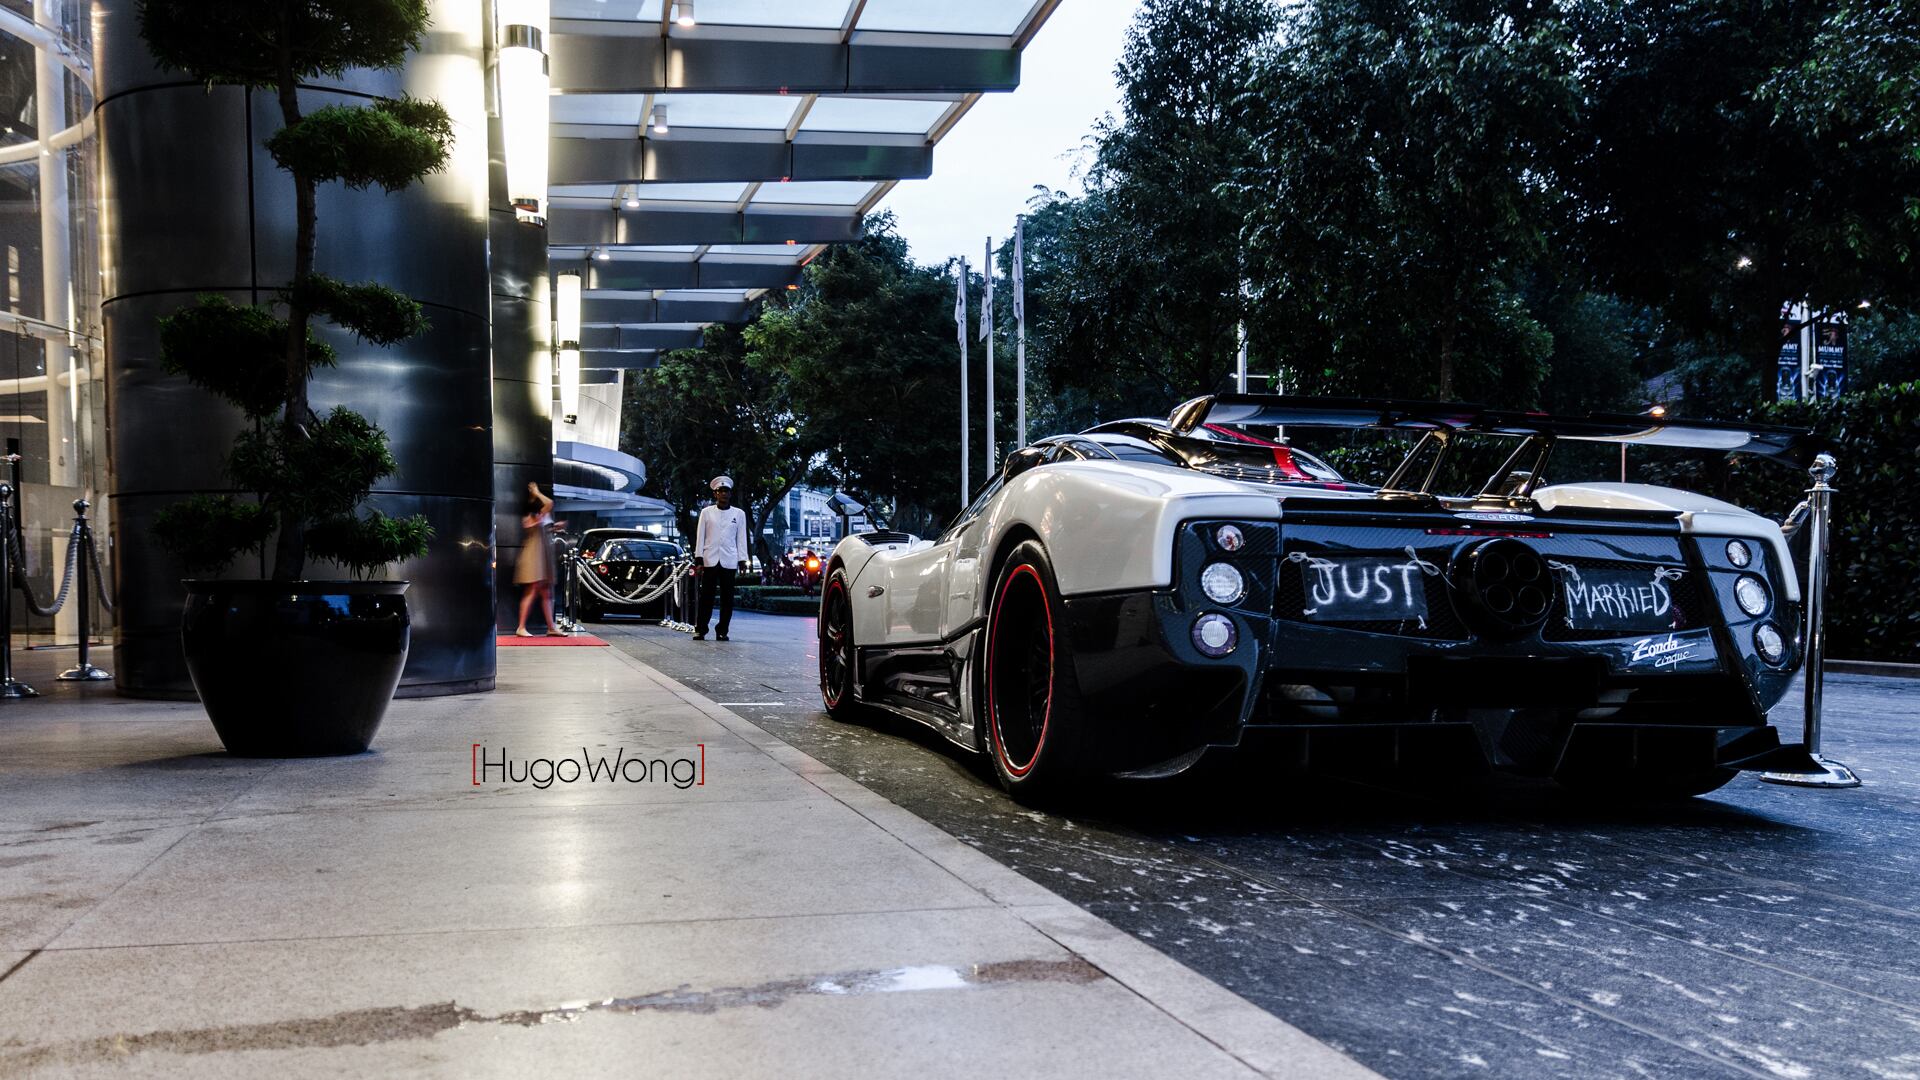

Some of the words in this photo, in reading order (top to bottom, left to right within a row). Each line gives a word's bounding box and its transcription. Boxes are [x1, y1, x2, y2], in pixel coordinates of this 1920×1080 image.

[1309, 564, 1419, 607] JUST
[1565, 581, 1670, 619] MARRIED
[1632, 633, 1688, 661] Zonda
[1655, 651, 1693, 670] cinque
